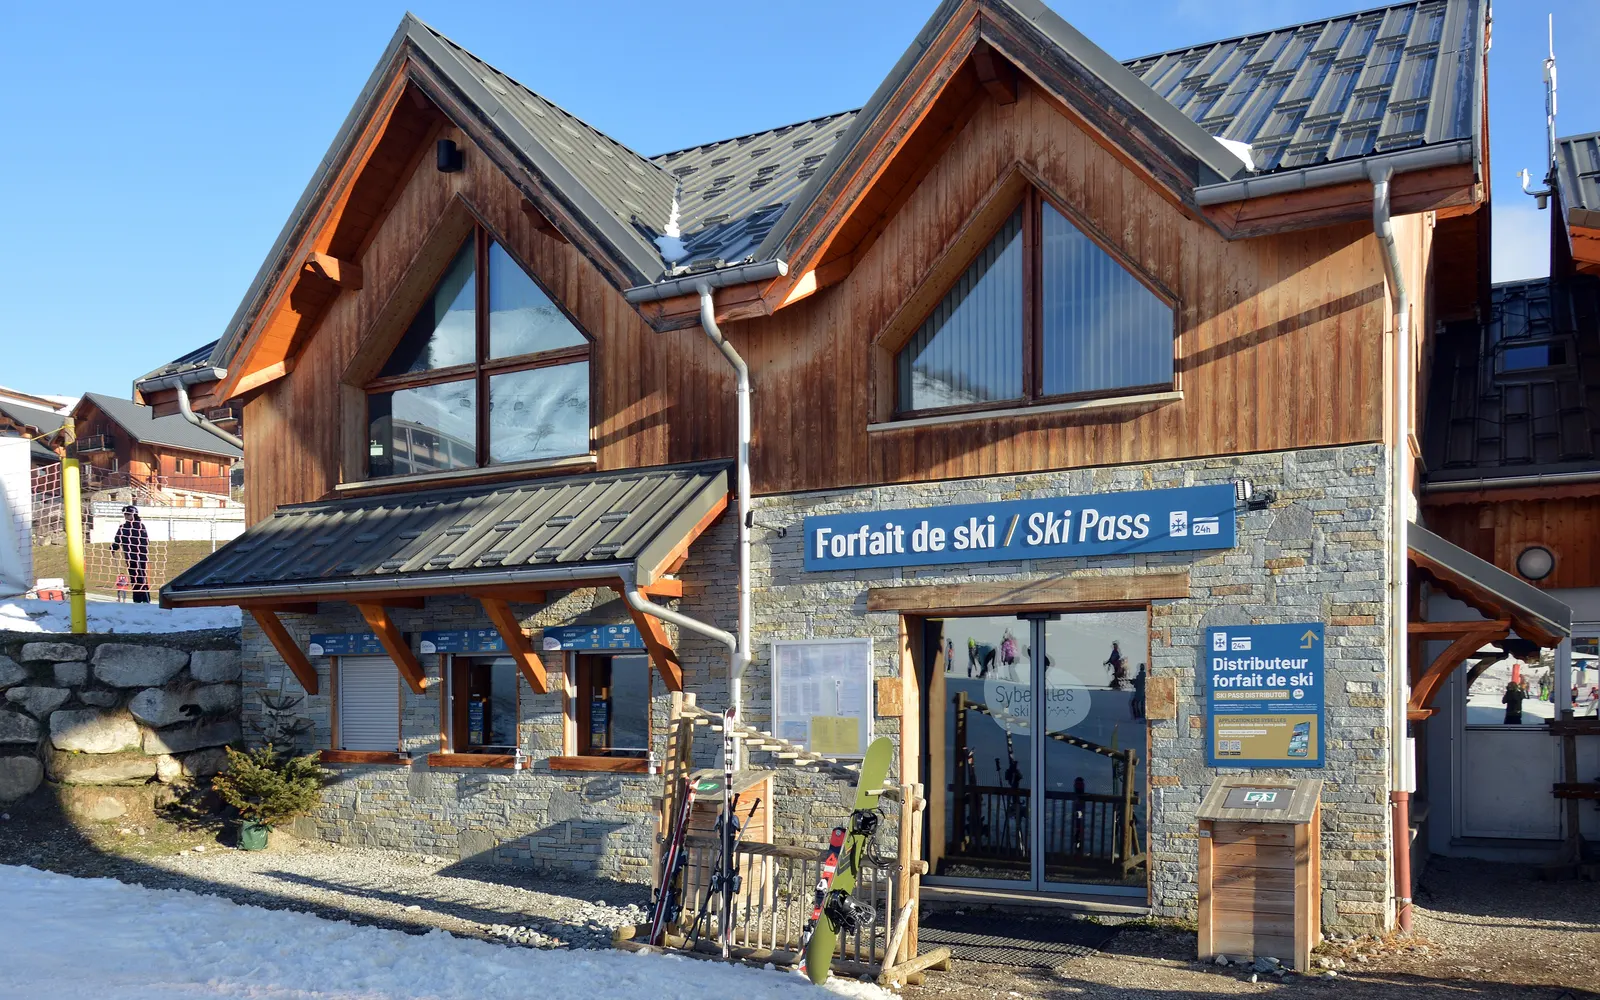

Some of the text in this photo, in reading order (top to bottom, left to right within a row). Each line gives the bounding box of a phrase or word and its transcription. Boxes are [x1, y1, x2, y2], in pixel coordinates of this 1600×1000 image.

[816, 508, 1150, 559] Forfait de ski / Ski Pass
[1194, 524, 1211, 534] 24h
[1213, 656, 1309, 671] Distributeur
[1212, 671, 1314, 688] forfait de ski
[1011, 704, 1029, 717] .ski
